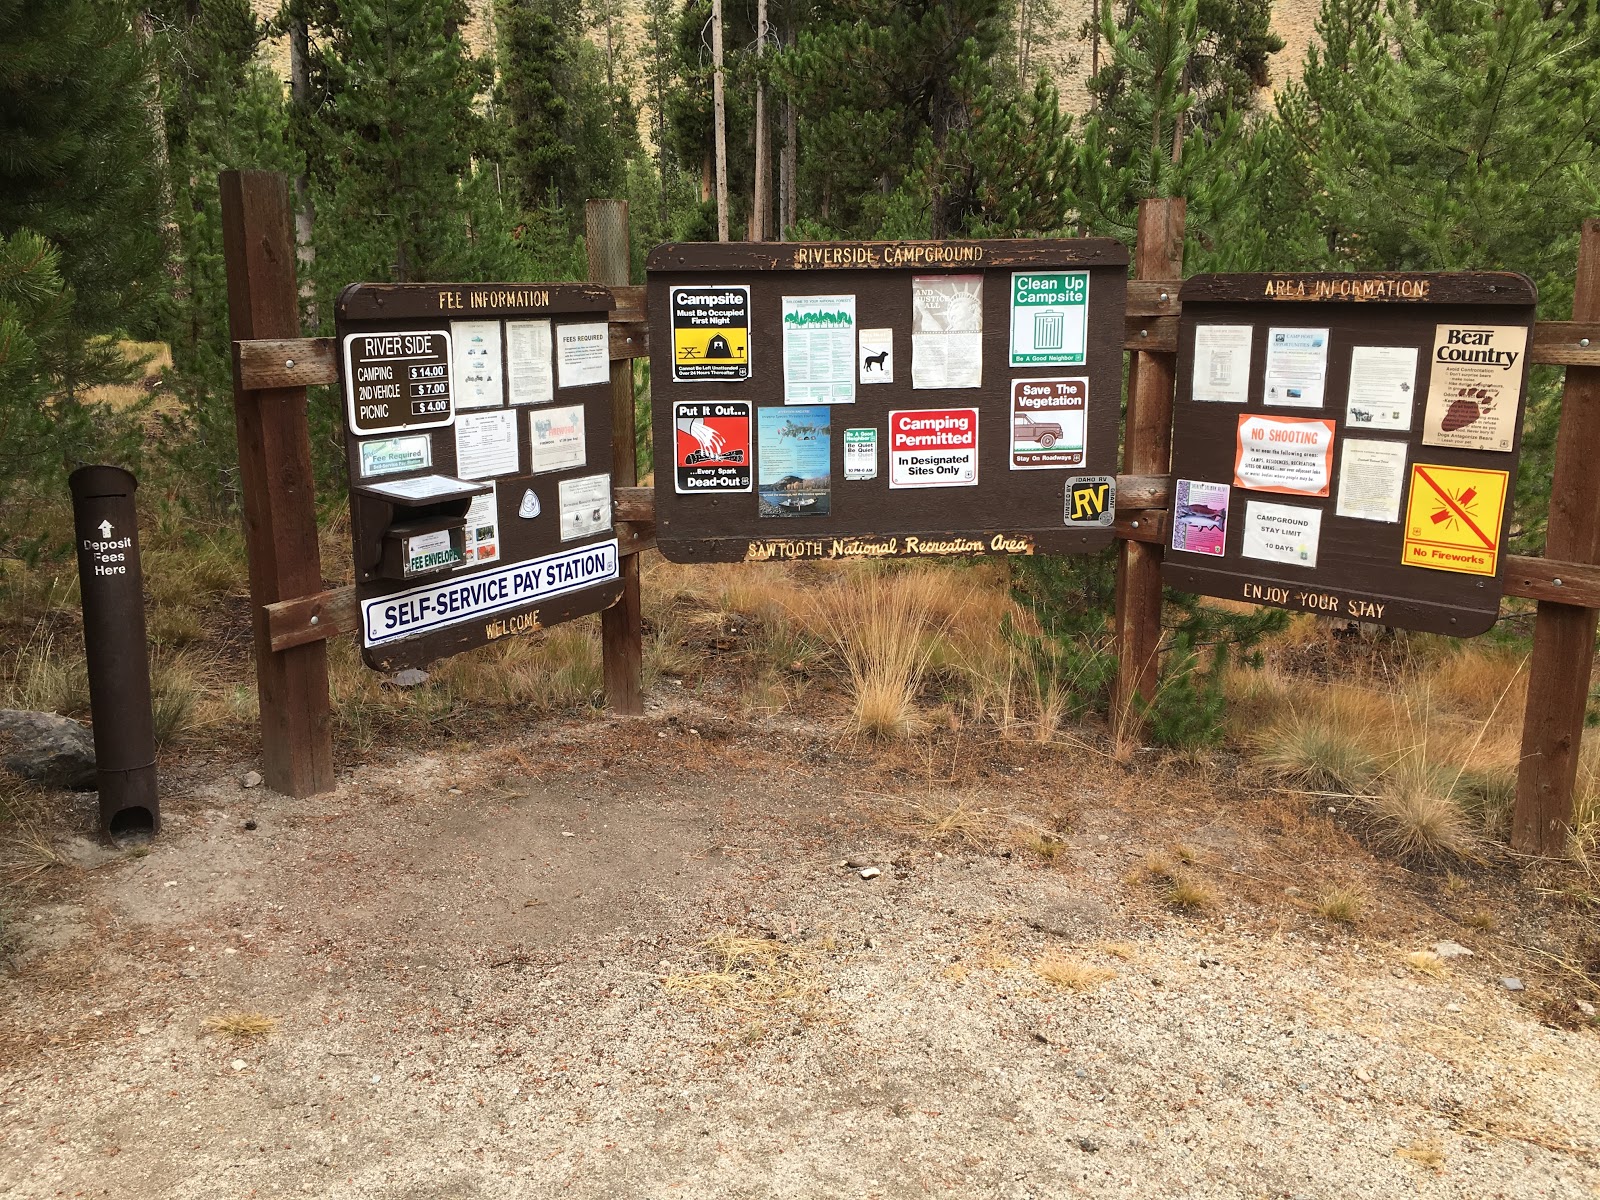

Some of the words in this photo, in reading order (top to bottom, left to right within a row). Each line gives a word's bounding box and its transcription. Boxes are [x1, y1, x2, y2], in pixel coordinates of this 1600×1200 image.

[799, 248, 872, 263] RIVERSIDE
[884, 247, 983, 263] CAMPGROUND
[1018, 277, 1057, 290] Clean
[1065, 277, 1084, 291] Up
[1265, 280, 1305, 296] AREA
[1314, 280, 1424, 296] INFORMATION
[439, 292, 463, 309] FEE
[470, 290, 549, 308] INFORMATION
[677, 293, 743, 307] Campsite
[1017, 290, 1083, 304] Campsite
[710, 317, 730, 325] Night
[1447, 330, 1494, 345] Bear
[365, 337, 402, 356] RIVER
[405, 336, 432, 354] SIDE
[1437, 346, 1520, 370] Country
[358, 366, 392, 381] CAMPING
[359, 386, 372, 400] 2ND
[374, 384, 400, 399] VEHICLE
[1024, 385, 1051, 396] Save
[1056, 384, 1077, 394] The
[1018, 396, 1082, 409] Vegetation
[360, 404, 389, 419] PICNIC
[680, 406, 698, 416] Put
[703, 406, 710, 415] It
[715, 406, 746, 415] Out...
[899, 416, 968, 431] Camping
[895, 431, 972, 446] Permitted
[1252, 428, 1264, 440] NO
[1269, 429, 1318, 444] SHOOTING
[389, 450, 421, 459] Required
[899, 457, 908, 465] In
[911, 455, 969, 466] Designated
[908, 467, 934, 475] Sites
[937, 466, 959, 475] Only
[688, 477, 740, 487] Dead-Out
[1072, 485, 1108, 519] RV
[1257, 514, 1309, 526] CAMPGROUND
[1281, 529, 1302, 537] LIMIT
[84, 538, 132, 552] Deposit
[749, 541, 822, 557] SAWTOOTH
[832, 538, 897, 555] National
[905, 537, 983, 552] Recreation
[991, 534, 1027, 550] Area
[1276, 544, 1294, 552] DAYS
[94, 553, 125, 562] Fees
[412, 556, 423, 570] FEE
[1413, 548, 1427, 557] No
[1432, 549, 1484, 565] Fireworks
[95, 565, 126, 576] Here
[384, 578, 509, 629] SELF-SERVICE
[514, 568, 542, 595] PAY
[546, 553, 606, 586] STATION
[1243, 583, 1289, 604] ENJOY
[1300, 592, 1338, 612] YOUR
[1348, 600, 1385, 618] STAY
[486, 610, 540, 640] WELCOME
